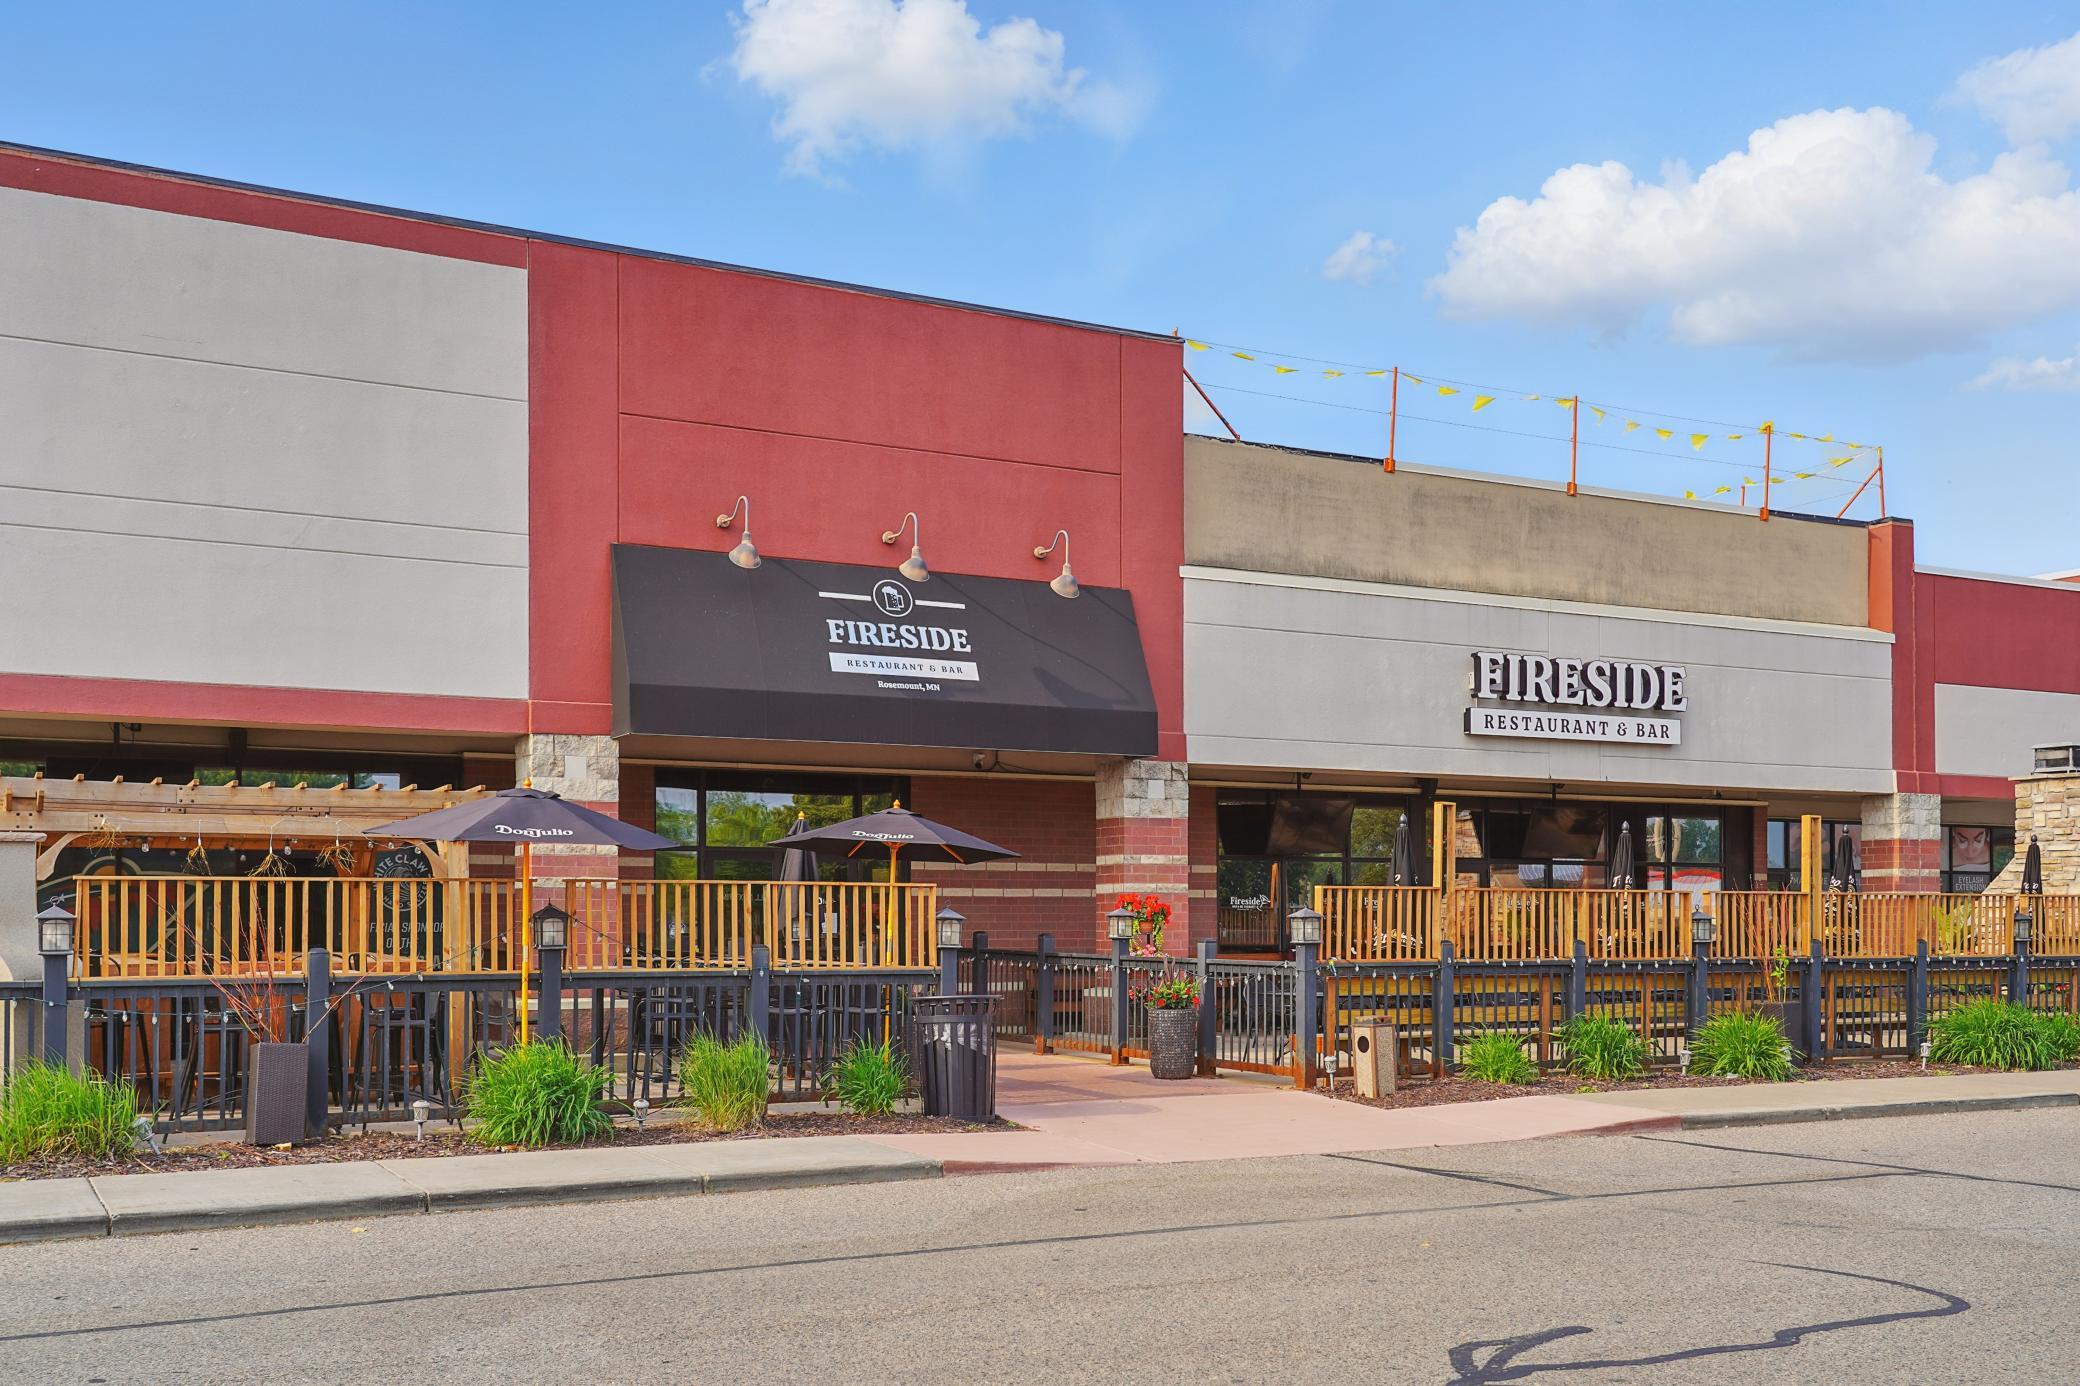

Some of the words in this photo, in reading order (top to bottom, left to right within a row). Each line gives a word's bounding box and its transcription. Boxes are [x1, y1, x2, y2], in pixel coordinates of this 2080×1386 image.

[826, 619, 971, 653] FIRESIDE
[847, 659, 924, 671] RESTAURANT
[941, 666, 964, 674] BAR
[877, 680, 925, 692] Rosemount,
[926, 683, 940, 691] MN
[1472, 651, 1688, 712] FIRESIDE
[1484, 714, 1609, 736] RESTAURANT
[1617, 722, 1628, 736] &
[1636, 724, 1670, 739] BAR
[394, 854, 429, 873] CLAW
[1958, 876, 1984, 884] EYELASH
[1230, 896, 1261, 905] Fireside
